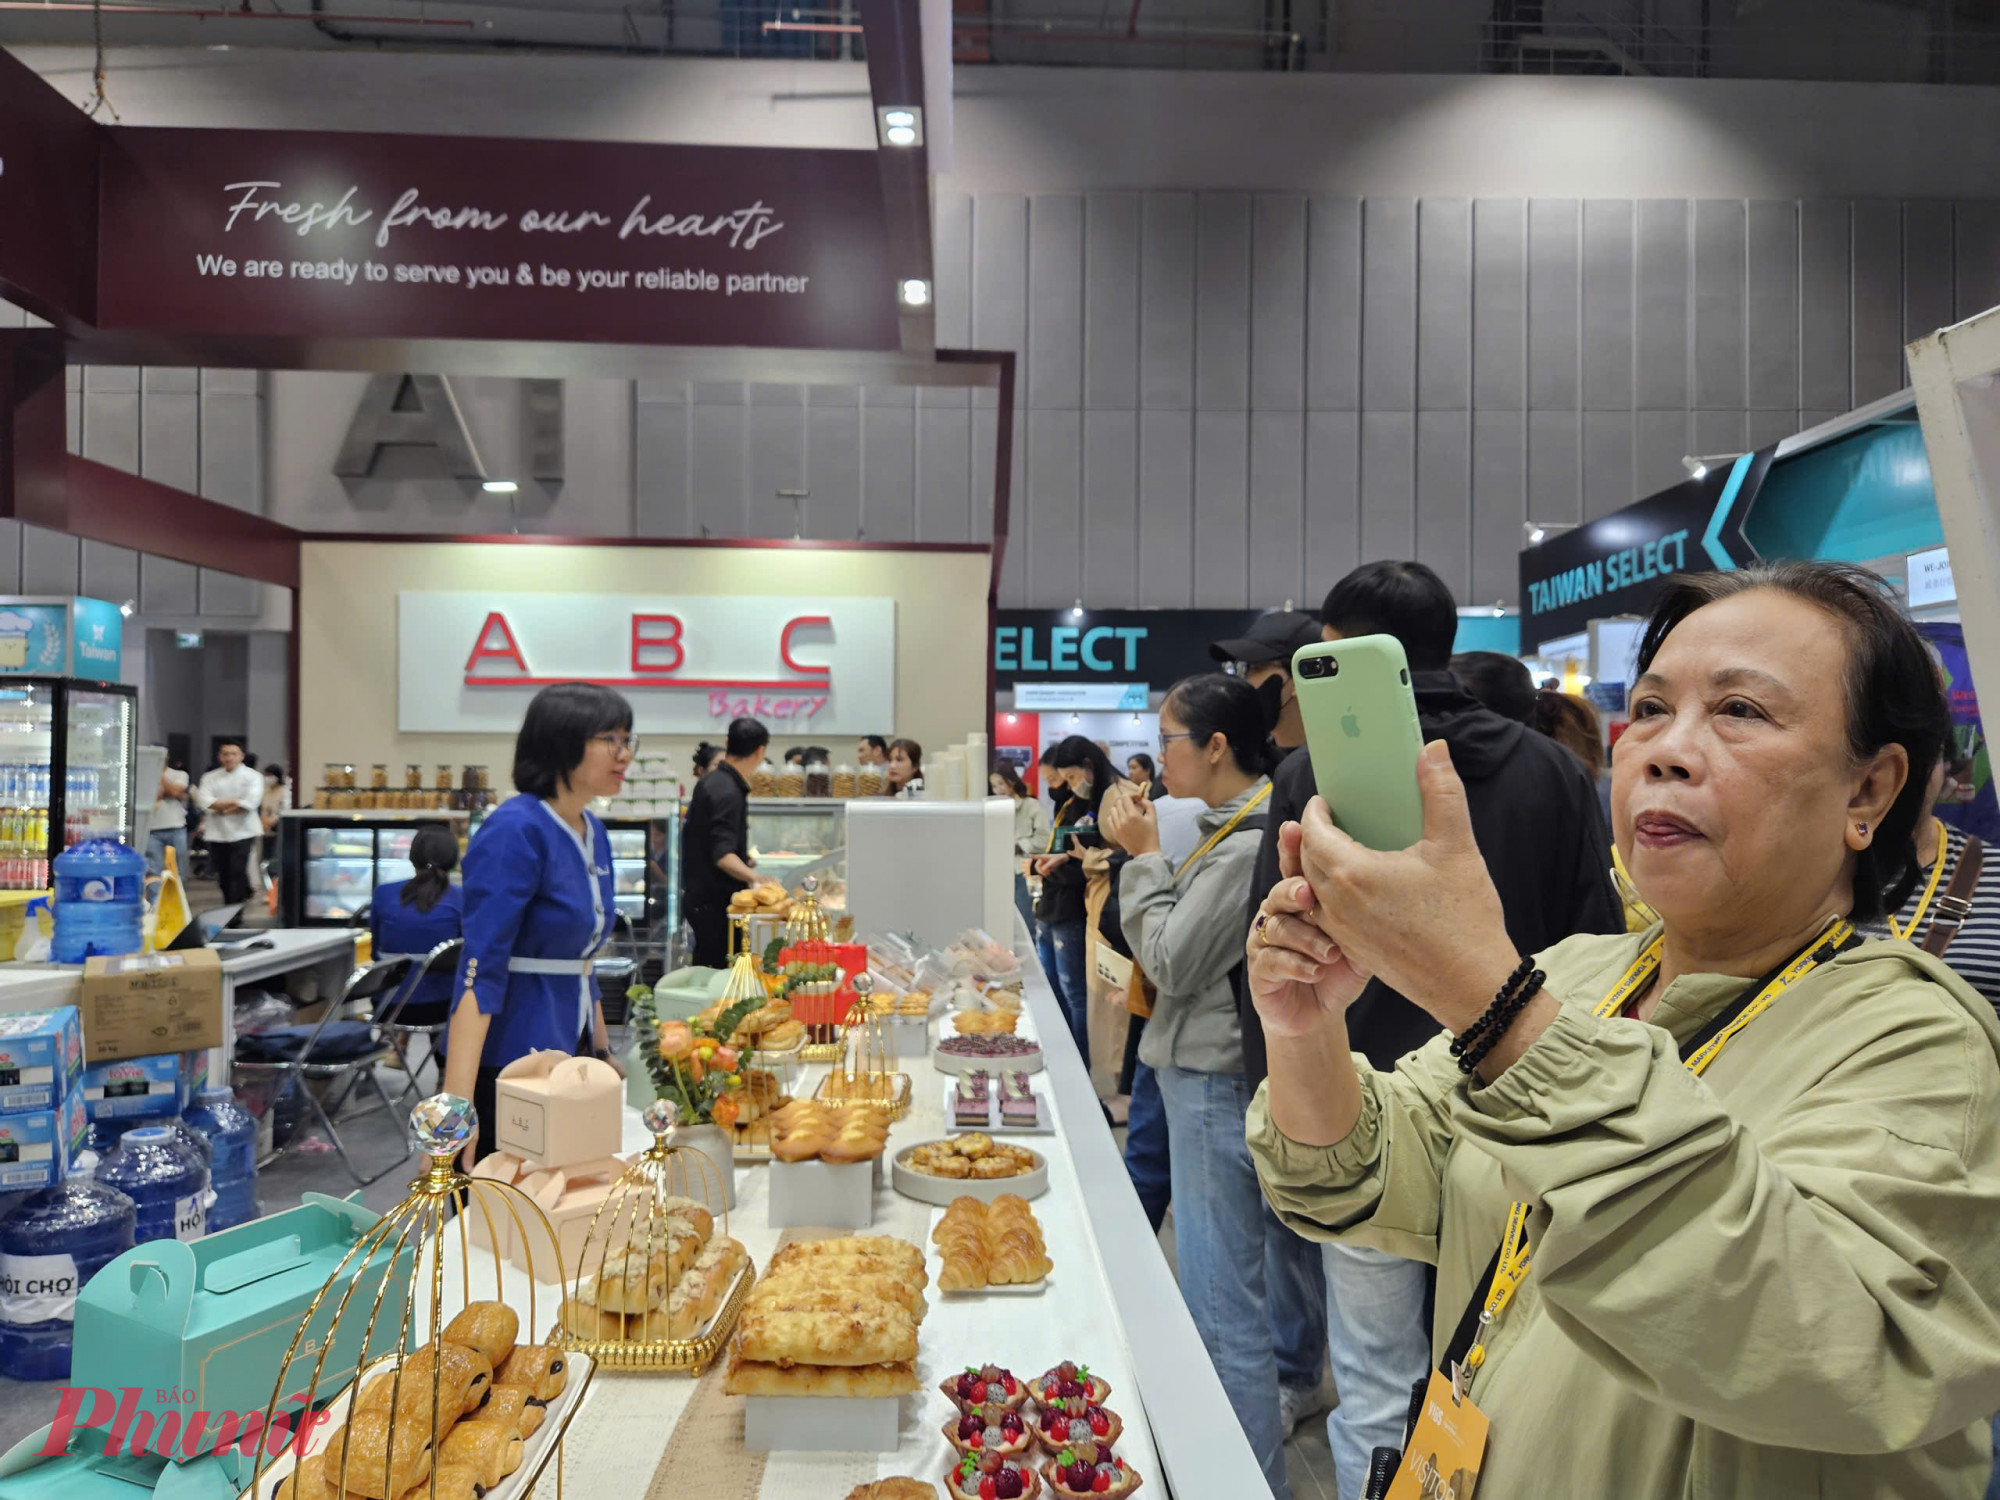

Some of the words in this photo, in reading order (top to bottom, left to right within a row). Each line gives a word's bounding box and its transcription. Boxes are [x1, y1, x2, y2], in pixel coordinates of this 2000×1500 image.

[223, 180, 373, 237] Fresh
[375, 187, 507, 248] from
[519, 209, 611, 233] our
[617, 194, 784, 251] hearts
[197, 253, 237, 277] We
[243, 258, 283, 278] are
[290, 257, 358, 285] ready
[364, 260, 388, 282] to
[393, 264, 461, 283] serve
[466, 267, 510, 289] you
[515, 262, 534, 286] &
[540, 263, 571, 287] be
[576, 269, 630, 293] your
[635, 267, 720, 291] reliable
[725, 271, 809, 296] partner
[1528, 560, 1603, 615] TAIWAN
[1606, 528, 1689, 592] SELECT
[80, 642, 117, 662] Taiwan
[995, 626, 1148, 671] ELECT
[708, 690, 828, 718] Bakery
[1495, 1288, 1506, 1302] LTD
